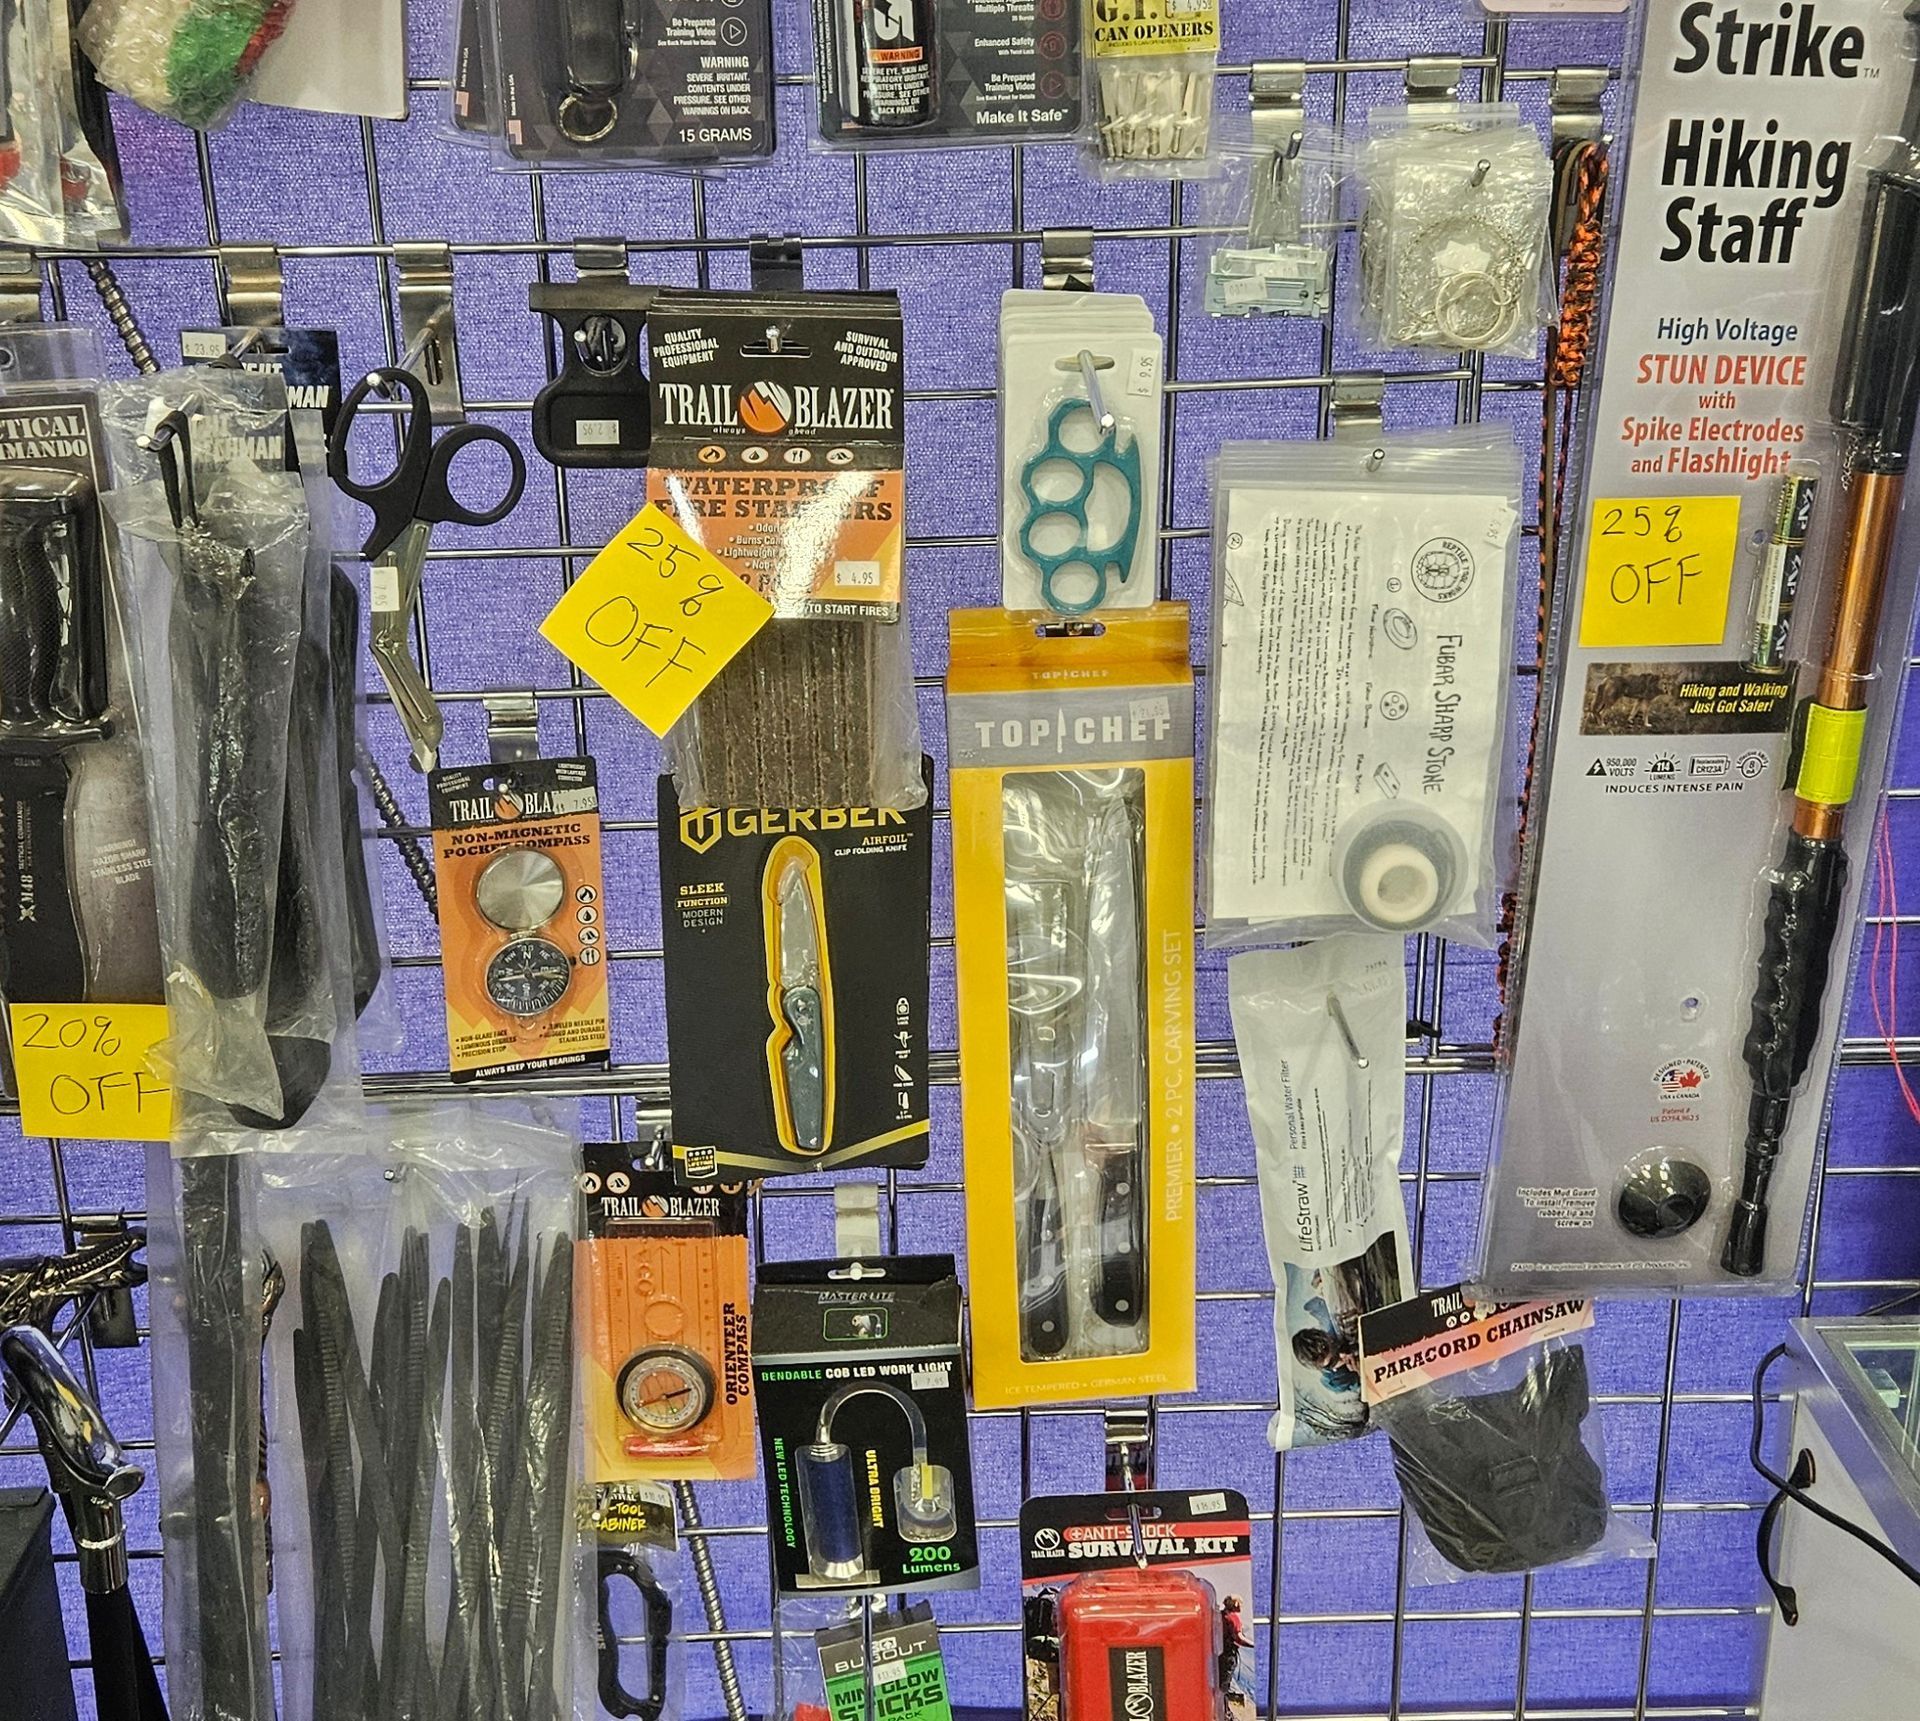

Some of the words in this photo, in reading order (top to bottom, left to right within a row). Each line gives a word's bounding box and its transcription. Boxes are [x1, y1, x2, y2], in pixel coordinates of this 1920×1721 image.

[975, 4, 1005, 14] Multiple
[1006, 3, 1034, 12] Threats
[666, 28, 695, 37] Training
[696, 27, 716, 36] Video
[672, 18, 682, 26] Be
[683, 18, 716, 28] Prepared
[1094, 26, 1129, 42] CAN
[1134, 21, 1214, 40] OPENERS
[974, 38, 1011, 47] Enhanced
[1011, 37, 1035, 47] Safety
[1673, 2, 1865, 78] Strike
[700, 56, 749, 68] WARNING
[880, 49, 920, 61] WARNING
[687, 73, 713, 82] SEVERE
[984, 83, 1014, 92] Training
[1015, 82, 1036, 91] Video
[991, 74, 1001, 82] Be
[1002, 72, 1035, 82] Prepared
[687, 84, 725, 93] CONTENTS
[726, 83, 751, 92] UNDER
[674, 95, 713, 105] PRESSURE.
[714, 95, 727, 104] SEE
[728, 94, 751, 104] OTHER
[682, 106, 719, 116] WARNINGS
[720, 106, 730, 115] ON
[976, 111, 1014, 124] Make
[1018, 109, 1028, 122] It
[679, 129, 695, 143] 15
[699, 127, 752, 142] GRAMS
[1661, 117, 1851, 208] Hiking
[1660, 196, 1808, 263] Staff
[664, 327, 702, 345] QUALITY
[845, 331, 891, 350] SURVIVAL
[1657, 317, 1709, 345] High
[1715, 318, 1798, 346] Voltage
[653, 337, 720, 358] PROFESSIONAL
[833, 340, 855, 354] AND
[854, 345, 898, 363] OUTDOOR
[662, 349, 714, 369] EQUIPMENT
[839, 353, 888, 373] APPROVED
[1637, 353, 1709, 385] STUN
[1713, 355, 1808, 385] DEVICE
[658, 383, 739, 426] TRAIL
[794, 385, 895, 430] BLAZER
[1698, 390, 1736, 410] with
[1621, 416, 1682, 447] Spike
[1688, 417, 1805, 443] Electrodes
[1631, 455, 1663, 474] and
[1667, 446, 1792, 480] Flashlight
[724, 547, 777, 559] Lightweight
[851, 571, 874, 585] 4.95
[1609, 552, 1704, 606] OFF
[809, 603, 822, 614] TO
[823, 603, 858, 616] START
[858, 603, 889, 617] FIRES
[584, 594, 707, 689] OFF
[1432, 634, 1464, 687] FUBAR
[1679, 684, 1716, 698] Hiking
[1718, 684, 1740, 697] and
[1742, 683, 1788, 698] Walking
[1429, 690, 1462, 743] SHARP
[1690, 701, 1715, 714] Just
[1716, 700, 1736, 713] Got
[1738, 700, 1774, 713] Safer!
[975, 719, 1051, 748] TOP
[1074, 715, 1171, 745] CHEF
[1421, 747, 1456, 795] STONE
[1608, 767, 1635, 777] VOLTS
[1605, 784, 1659, 794] INDUCES
[1662, 783, 1712, 793] INTENSE
[1715, 782, 1744, 791] PAIN
[449, 797, 495, 823] TRAIL
[451, 822, 582, 846] NON-MAGNETIC
[834, 848, 851, 857] CLIP
[852, 846, 884, 856] FOLDING
[885, 844, 908, 853] KNIFE
[680, 882, 725, 896] SLEEK
[676, 896, 728, 908] FUNCTION
[682, 909, 724, 919] MODERN
[683, 917, 724, 929] DESIGN
[1164, 928, 1182, 969] SET
[1164, 971, 1183, 1068] CARVING
[22, 1012, 121, 1057] 20%
[475, 1064, 505, 1077] ALWAYS
[506, 1062, 525, 1074] KEEP
[526, 1060, 548, 1070] YOUR
[549, 1054, 586, 1067] BEARINGS
[1280, 1059, 1291, 1083] Filter
[49, 1071, 171, 1116] OFF
[1282, 1084, 1294, 1112] Water
[1285, 1111, 1299, 1150] Personal
[1165, 1138, 1183, 1222] PREMIER
[601, 1196, 642, 1217] TRAIL
[670, 1196, 720, 1217] BLAZER
[1292, 1179, 1313, 1253] LifeStraw
[1431, 1291, 1463, 1318] TRAIL
[1373, 1333, 1482, 1384] PARACORD
[1486, 1298, 1585, 1344] CHAINSAW
[723, 1302, 739, 1406] ORIENTEER
[734, 1313, 751, 1397] COMPASS
[761, 1369, 822, 1382] BENDABLE
[825, 1368, 851, 1380] COB
[853, 1366, 876, 1379] LED
[879, 1364, 915, 1376] WORK
[917, 1362, 953, 1374] LIGHT
[1024, 1382, 1080, 1394] TEMPERED
[774, 1437, 784, 1465] NEW
[777, 1462, 788, 1481] LED
[865, 1449, 879, 1486] ULTRA
[780, 1480, 796, 1549] TECHNOLOGY
[868, 1485, 884, 1529] BRIGHT
[909, 1546, 952, 1562] 200
[1068, 1537, 1190, 1560] SURVVAL
[1194, 1536, 1239, 1553] KIT
[902, 1561, 961, 1575] Lumens
[881, 1667, 940, 1695] GLOW
[1125, 1650, 1148, 1694] BLAZER
